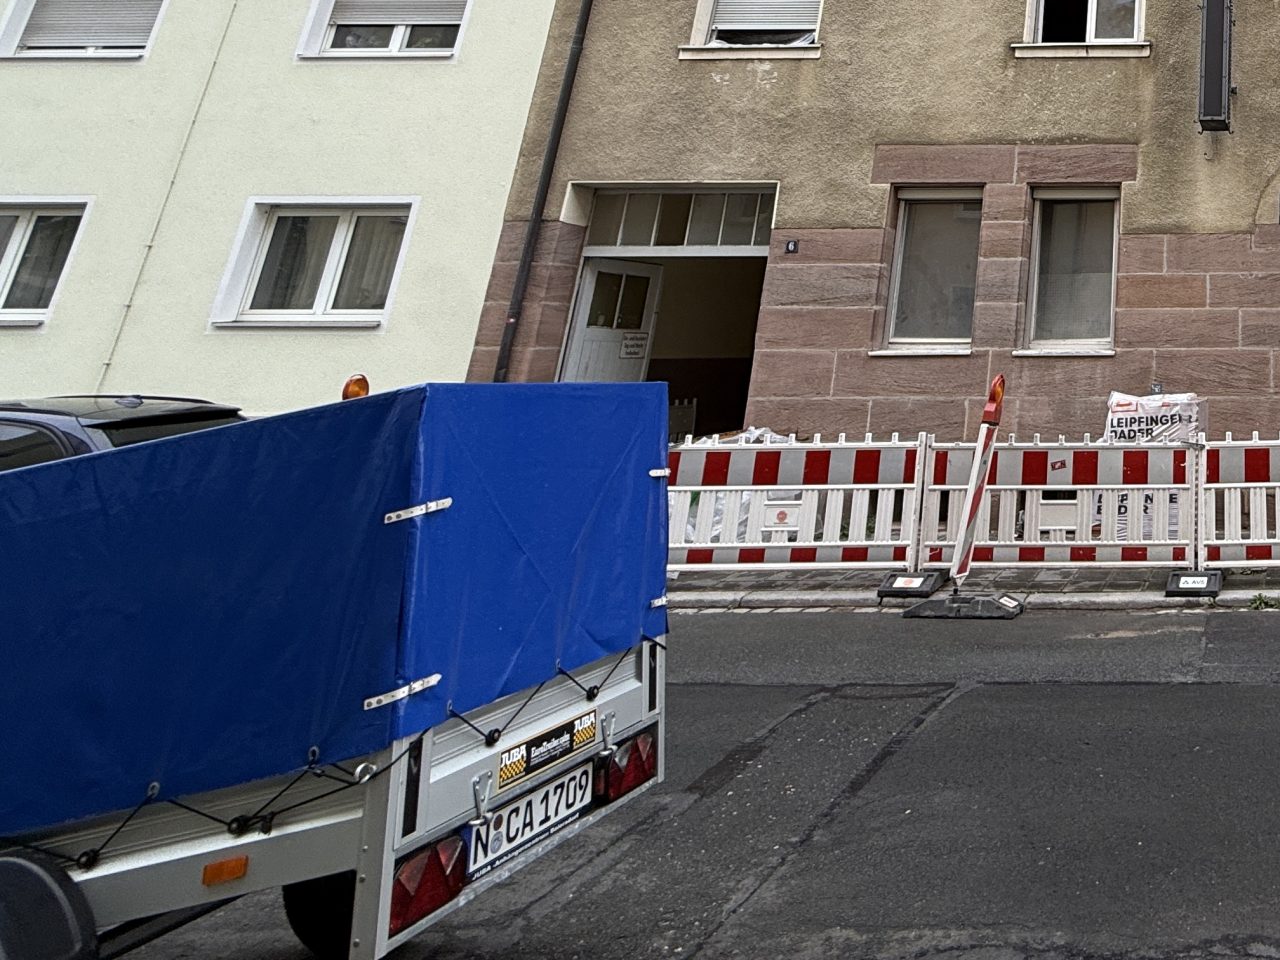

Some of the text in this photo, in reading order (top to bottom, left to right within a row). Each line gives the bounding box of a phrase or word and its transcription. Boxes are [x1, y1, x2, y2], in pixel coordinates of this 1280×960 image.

[788, 241, 794, 251] 6
[573, 712, 595, 733] JUBA
[501, 744, 527, 768] JUBA
[473, 769, 589, 865] N CA 1709
